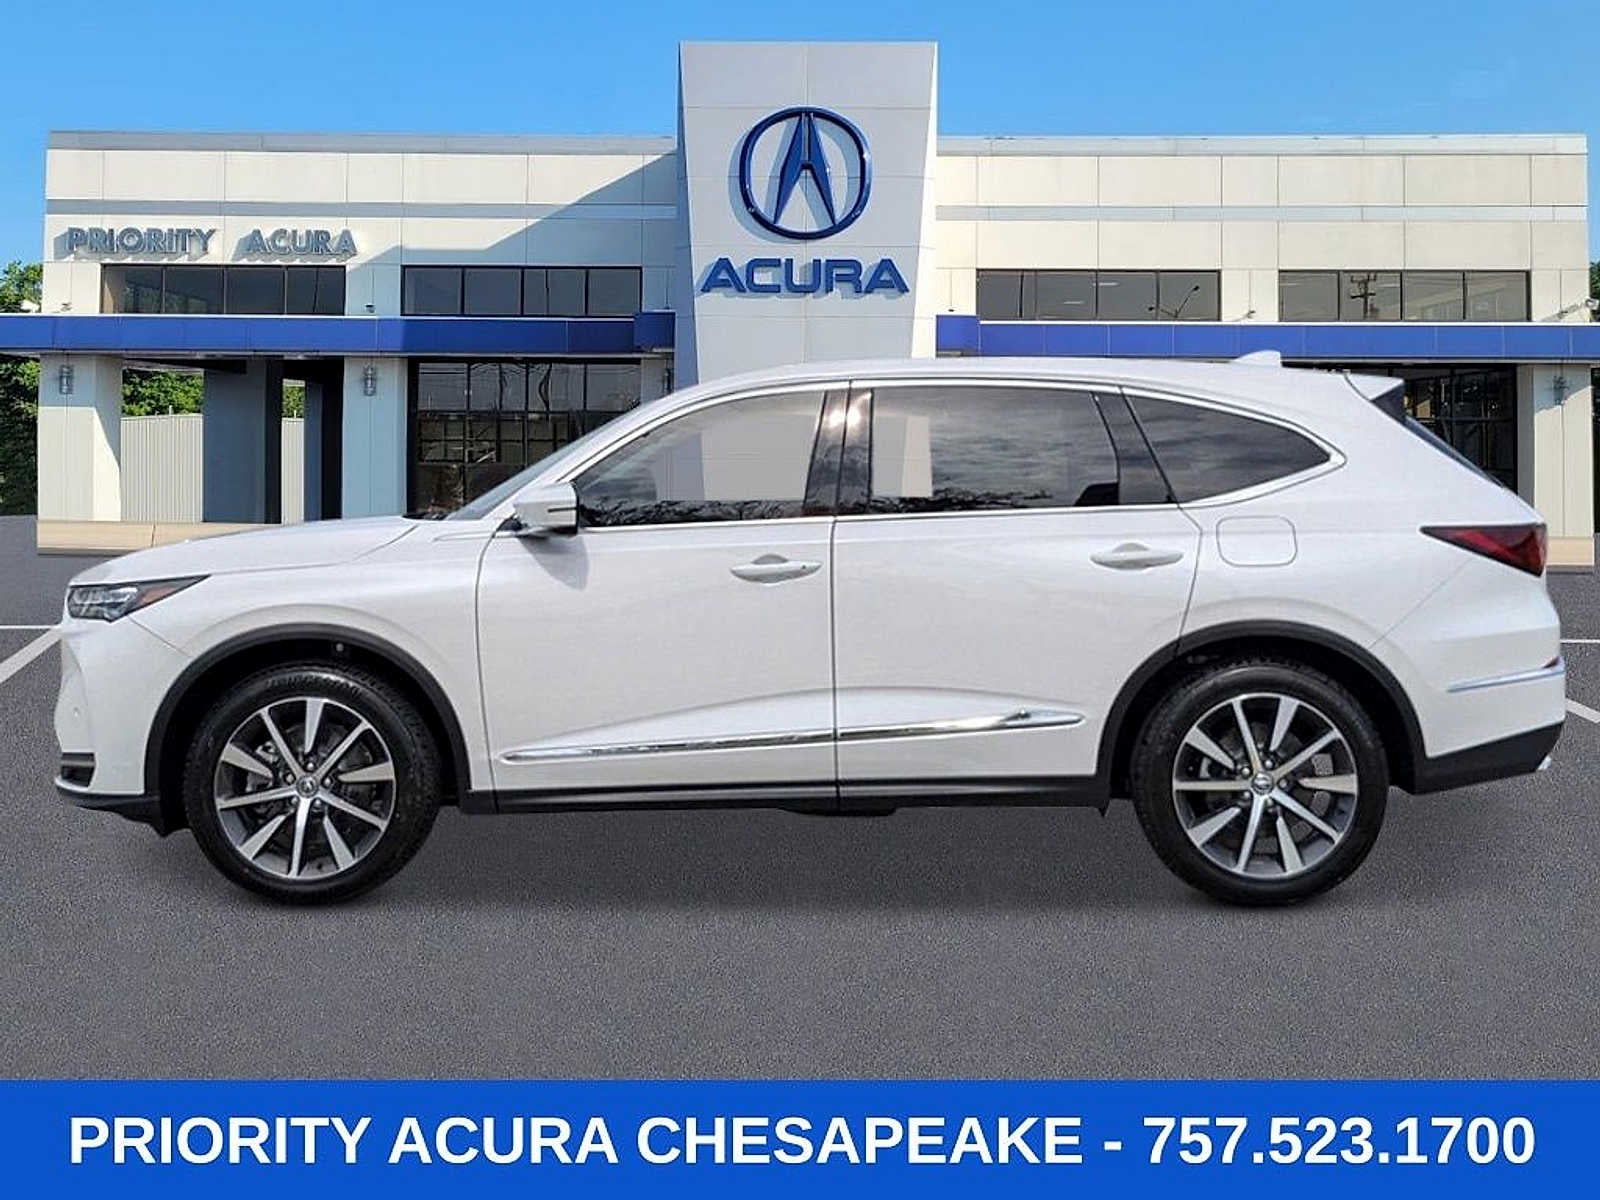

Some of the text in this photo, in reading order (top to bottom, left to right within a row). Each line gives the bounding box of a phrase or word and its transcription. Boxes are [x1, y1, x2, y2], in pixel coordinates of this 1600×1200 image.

[67, 227, 357, 256] PRIORITY ACURA
[700, 257, 910, 293] ACURA
